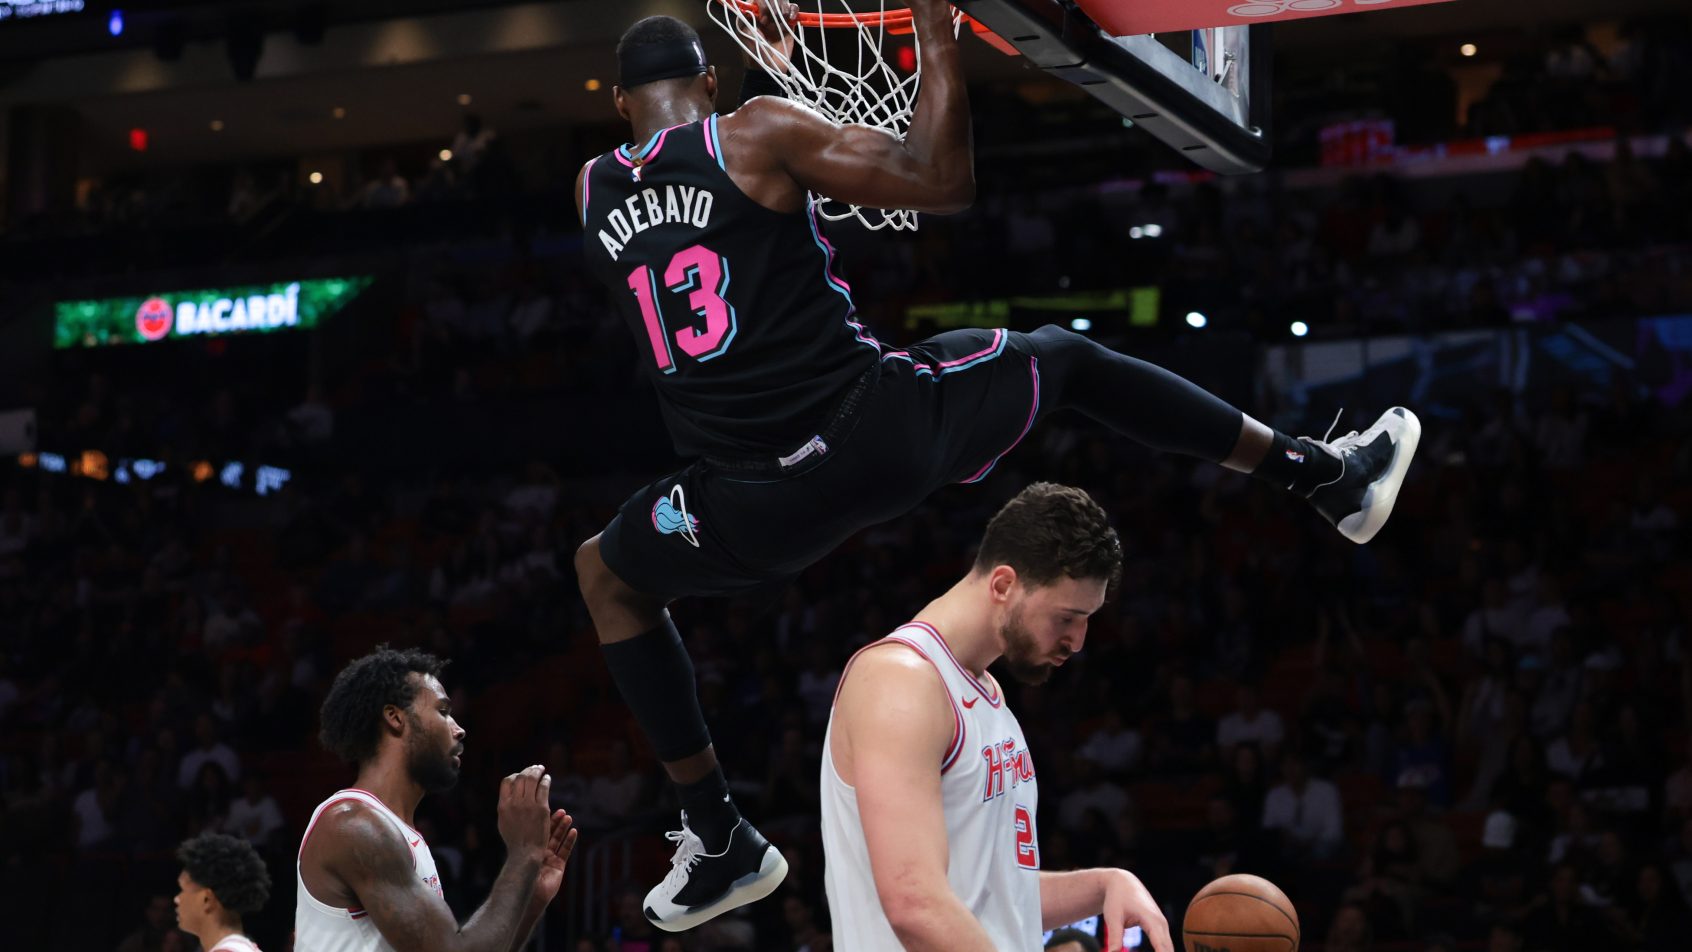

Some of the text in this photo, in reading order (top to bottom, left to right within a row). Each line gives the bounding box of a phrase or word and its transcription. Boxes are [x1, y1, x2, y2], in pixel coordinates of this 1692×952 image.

[598, 185, 713, 261] ADEBAYO
[175, 282, 299, 334] BACARDÍ
[627, 244, 737, 374] 13
